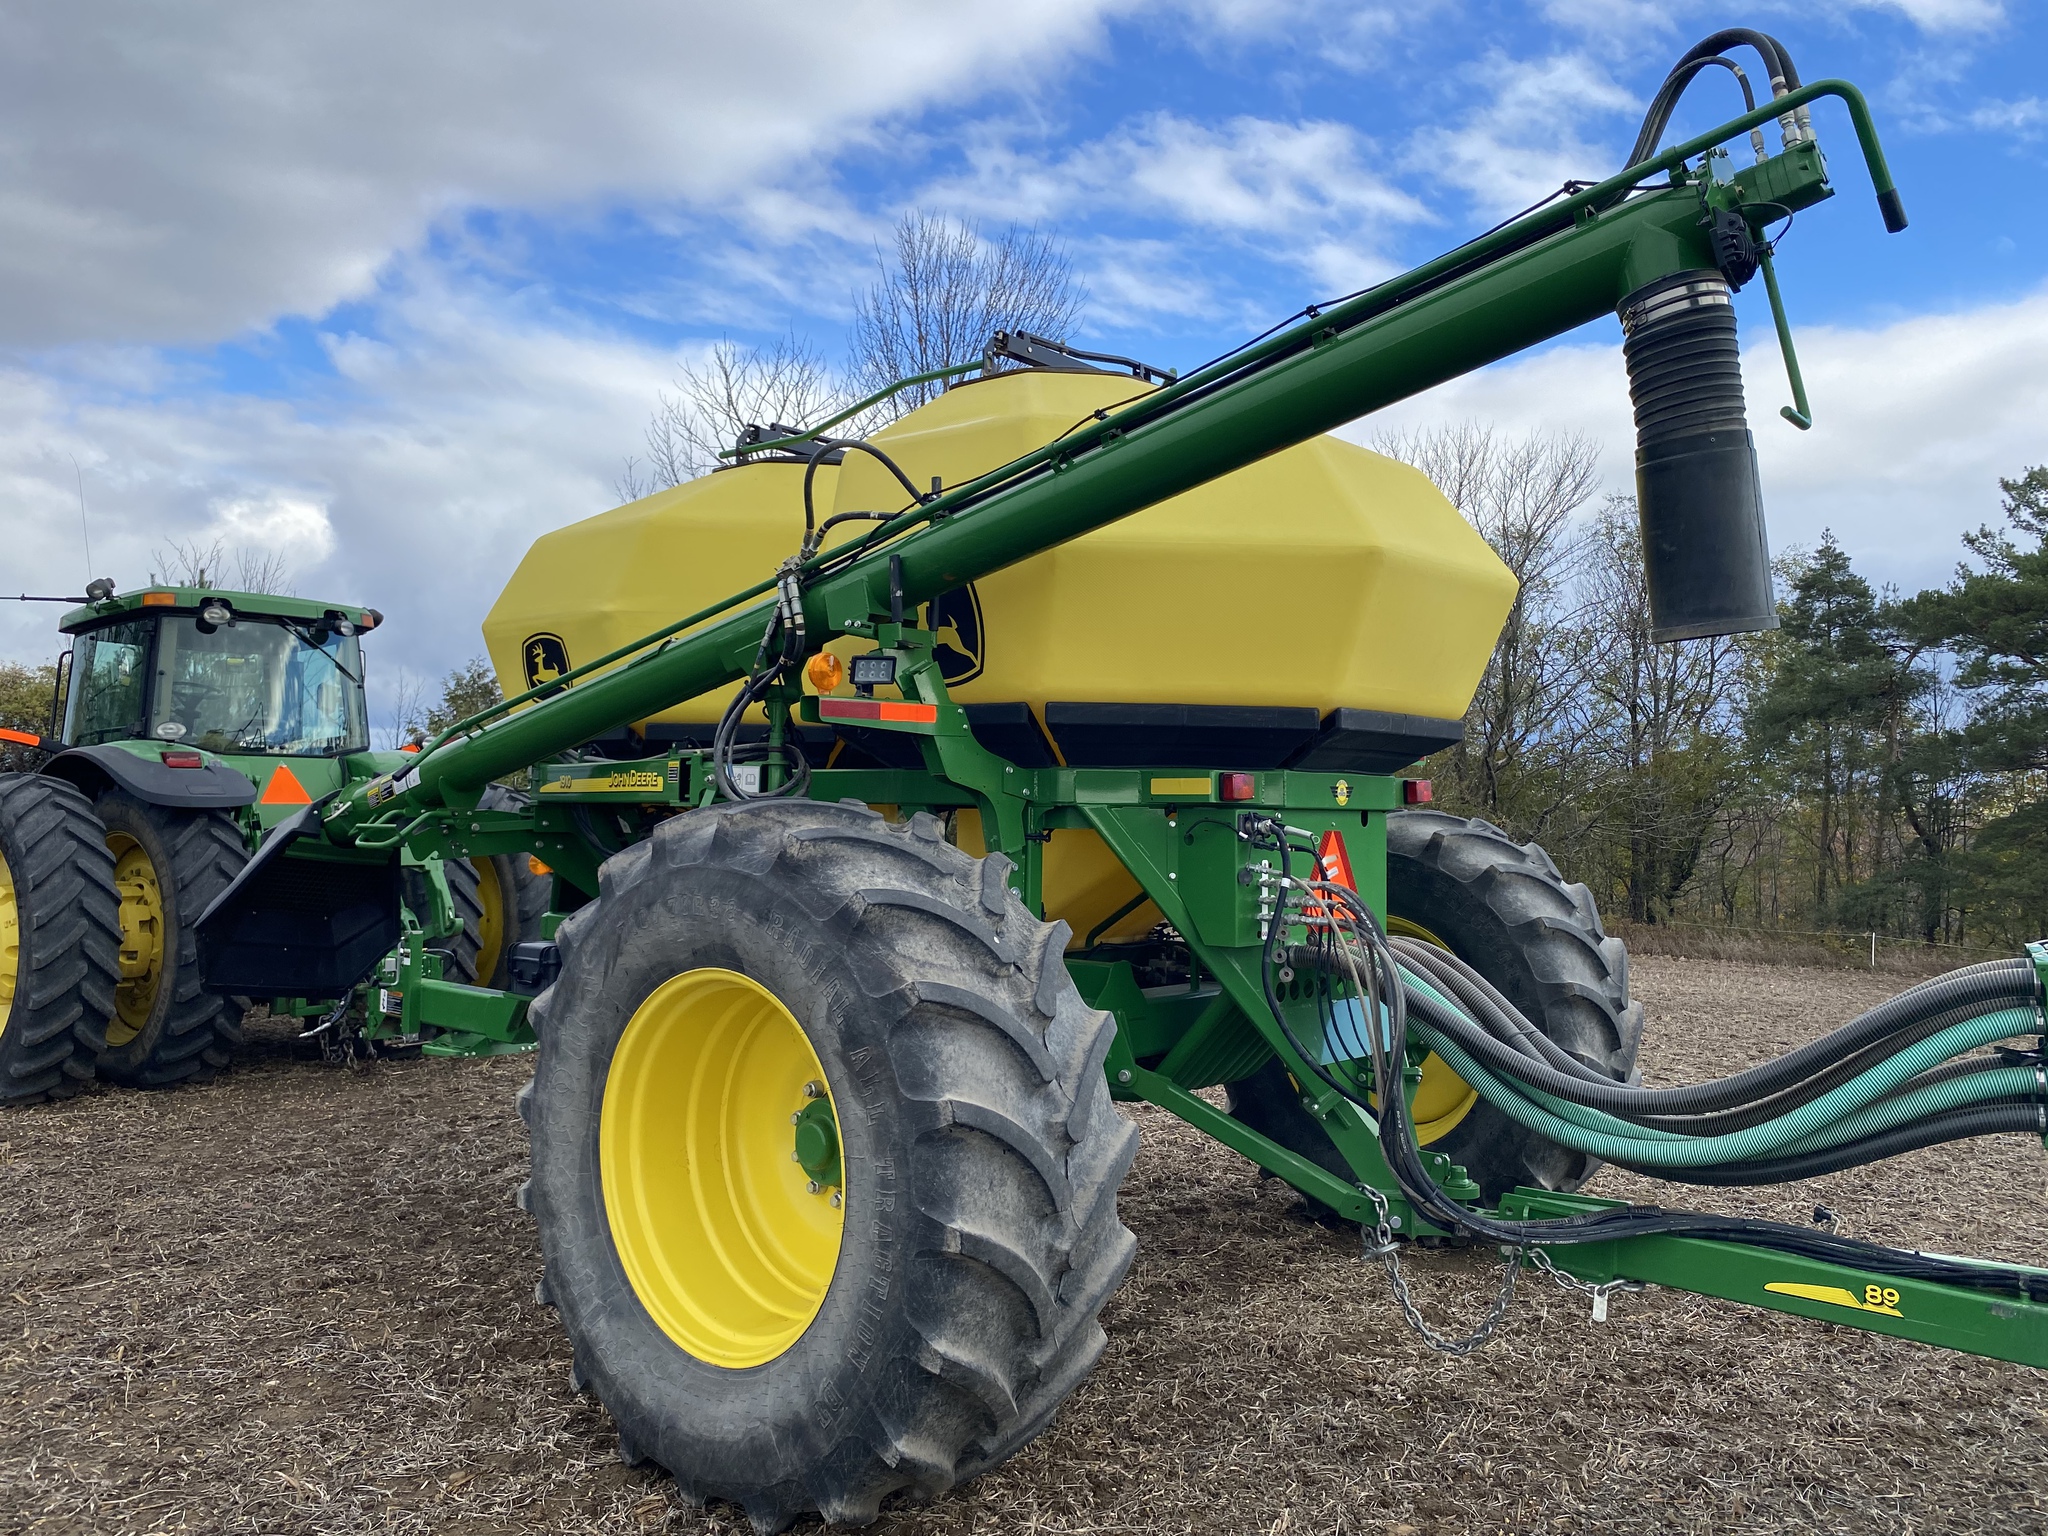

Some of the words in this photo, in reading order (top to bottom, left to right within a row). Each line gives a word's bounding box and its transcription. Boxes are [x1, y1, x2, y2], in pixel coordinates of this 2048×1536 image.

[766, 910, 850, 1027] RADIAL
[850, 1046, 887, 1127] ALL
[847, 1154, 897, 1373] TRACTION
[1864, 1284, 1900, 1307] 89
